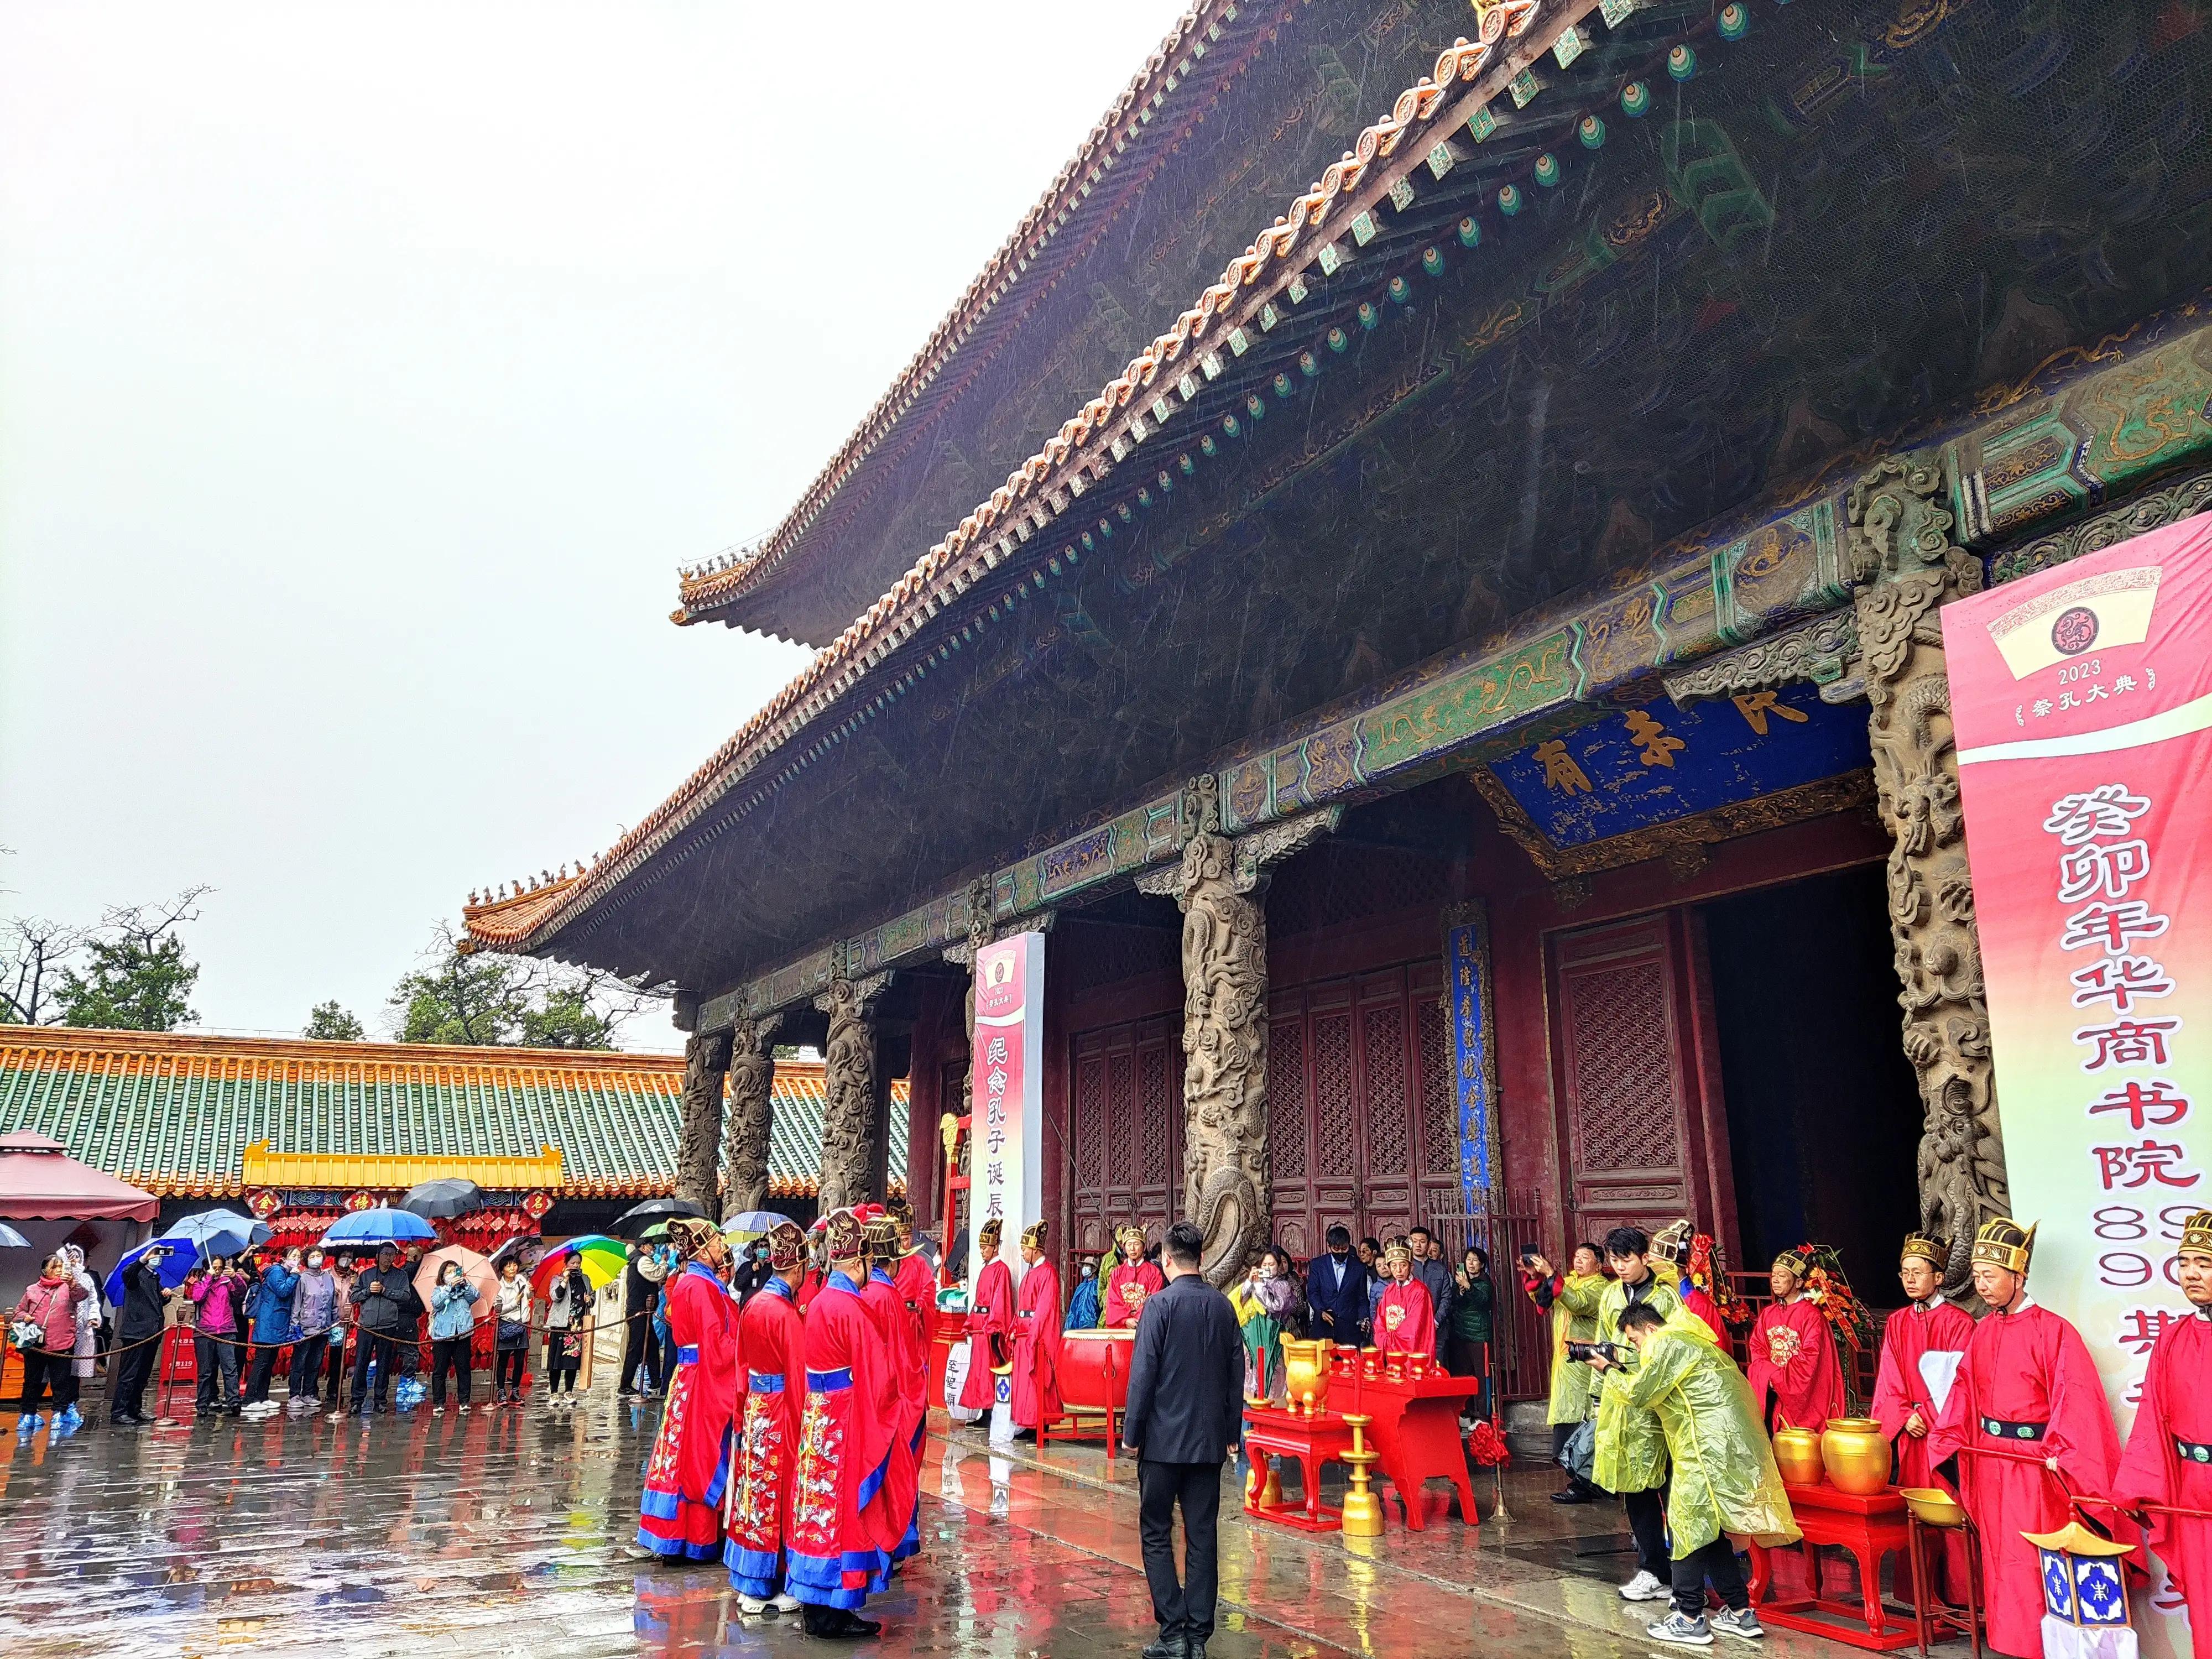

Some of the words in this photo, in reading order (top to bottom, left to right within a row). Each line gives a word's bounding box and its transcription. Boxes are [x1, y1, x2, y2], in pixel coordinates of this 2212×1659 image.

[2058, 659, 2101, 685] 2023
[2031, 674, 2138, 718] 祭孔大典
[257, 1194, 274, 1209] 金
[354, 1195, 369, 1210] 榜
[531, 1196, 543, 1209] 名
